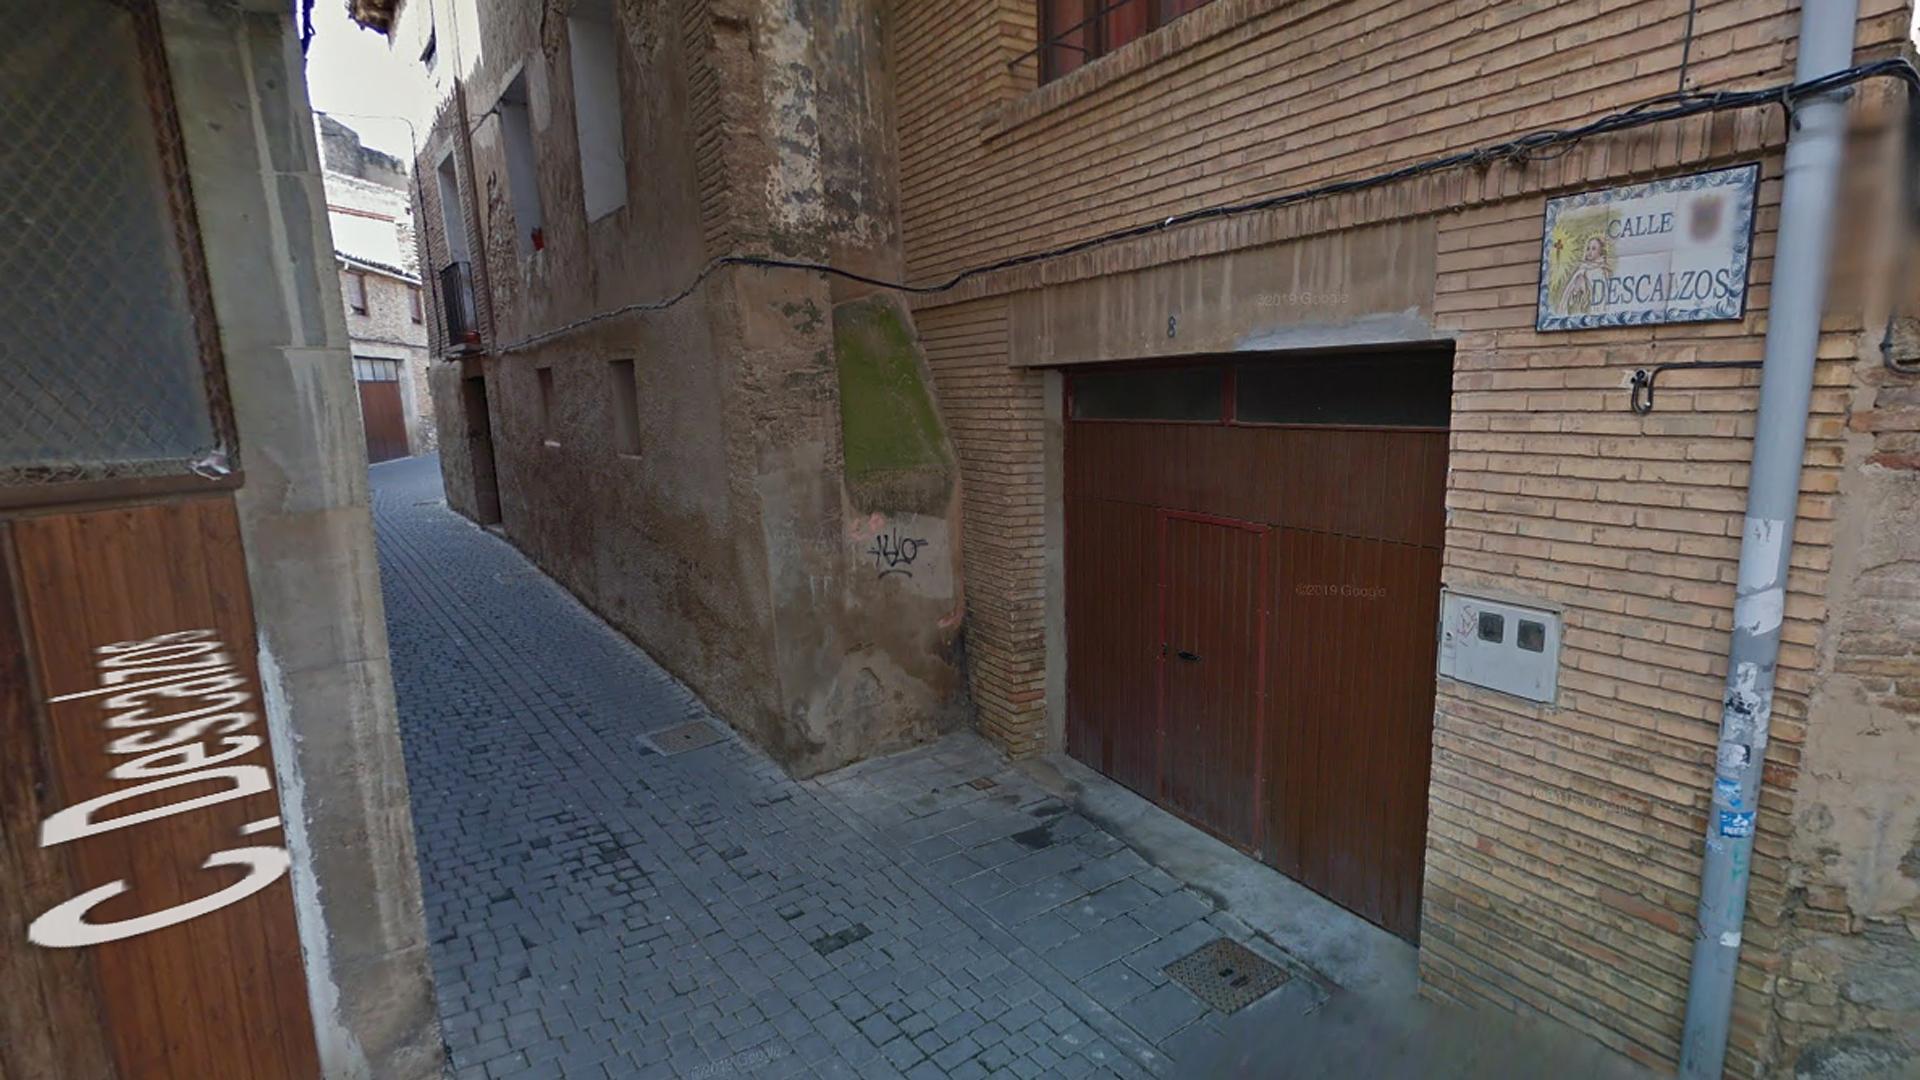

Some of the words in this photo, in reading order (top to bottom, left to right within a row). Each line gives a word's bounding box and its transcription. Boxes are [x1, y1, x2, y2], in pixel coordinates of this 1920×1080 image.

[1607, 212, 1673, 239] CALLE
[1592, 268, 1729, 306] DESCALZOS
[1167, 316, 1176, 338] 8
